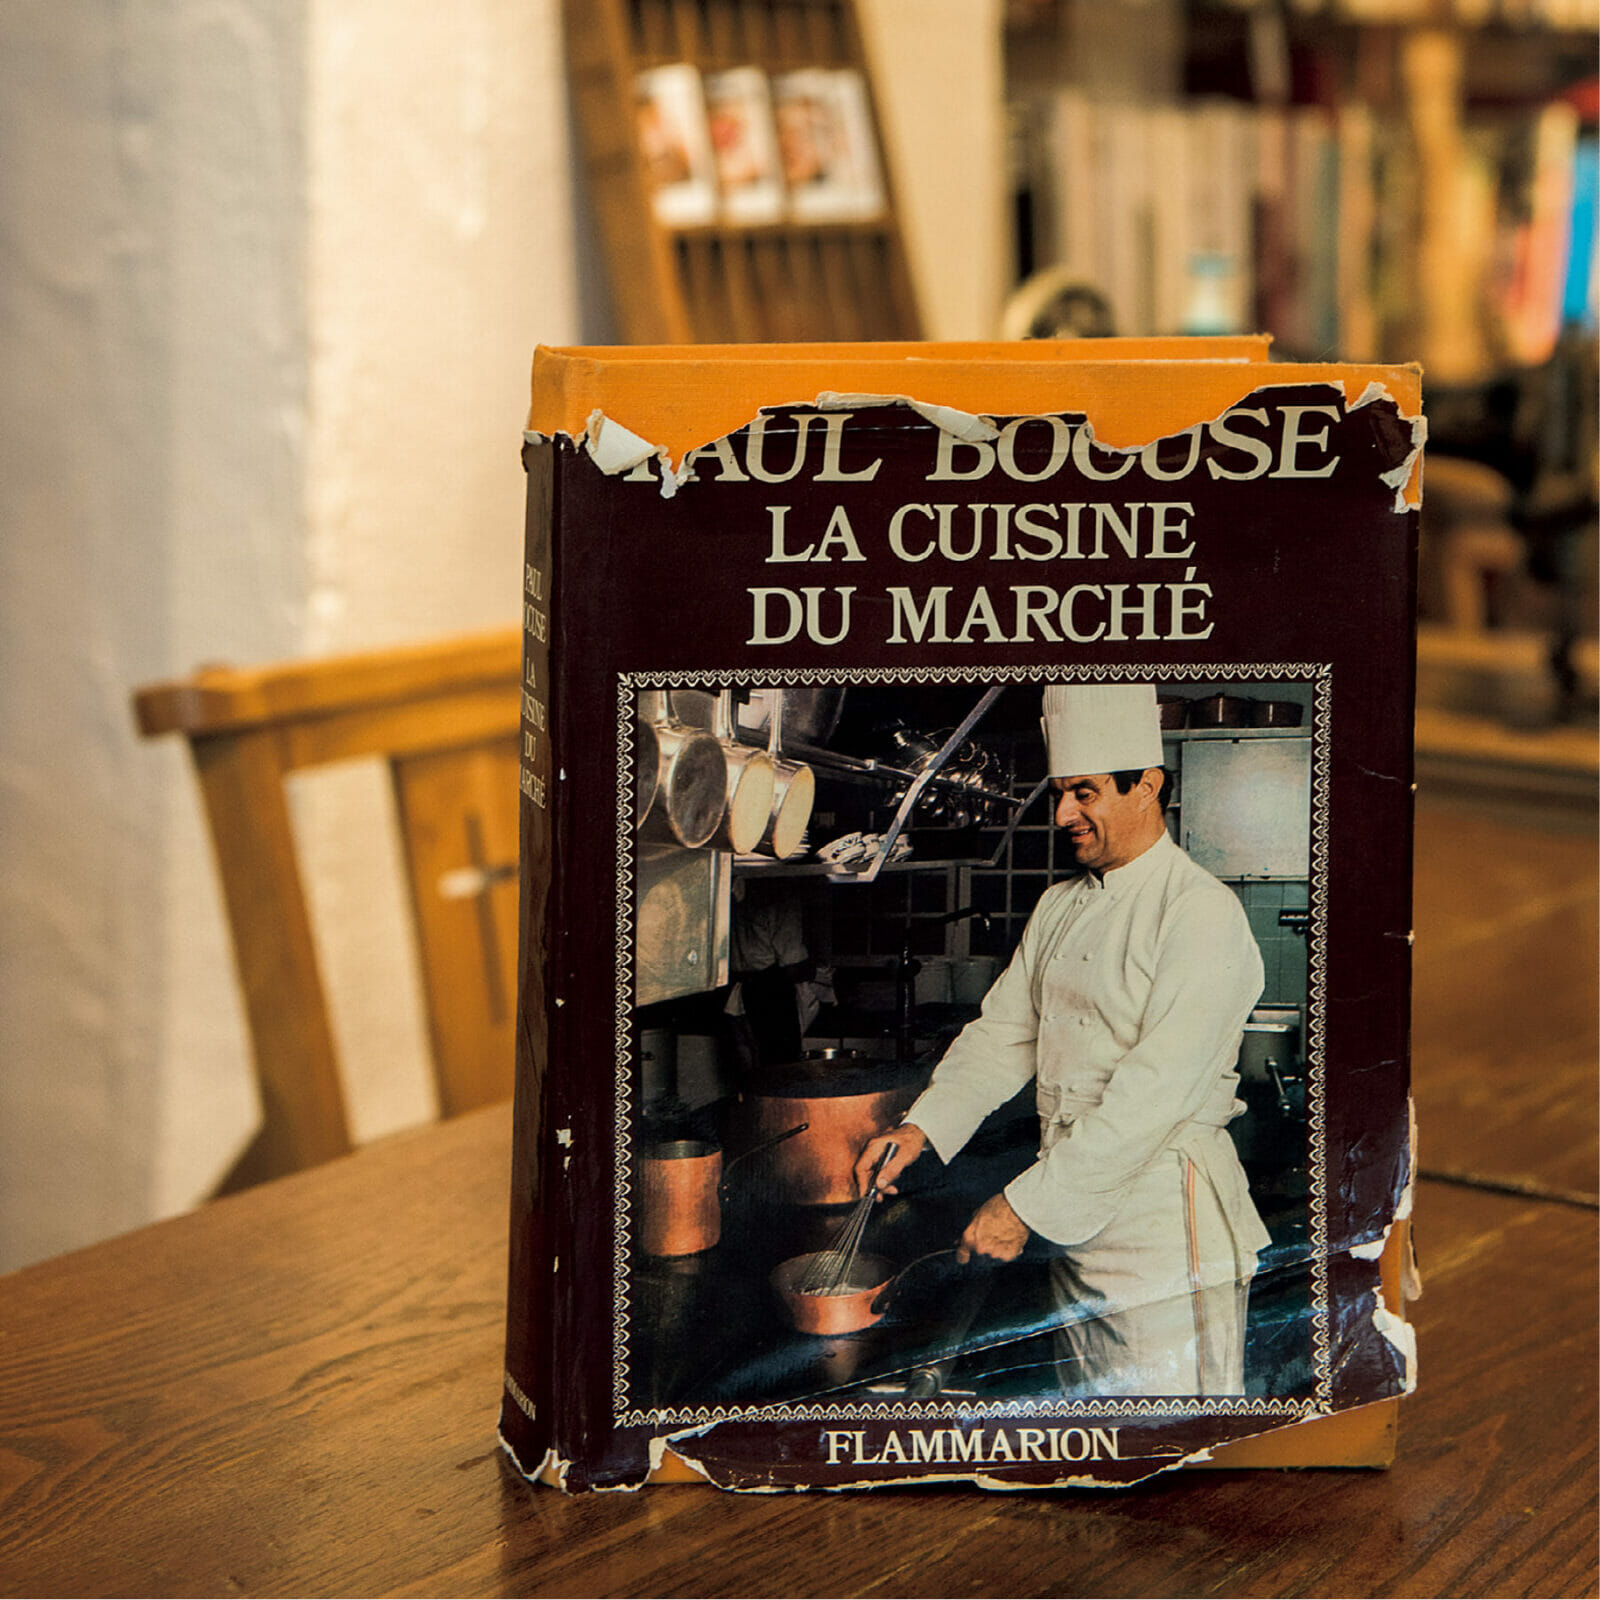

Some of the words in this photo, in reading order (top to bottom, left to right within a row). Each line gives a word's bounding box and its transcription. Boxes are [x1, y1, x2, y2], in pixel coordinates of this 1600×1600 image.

[765, 505, 867, 562] LA
[888, 502, 1196, 562] CUISINE
[746, 586, 857, 645] DU
[886, 566, 1215, 644] MARCHÉ
[825, 1427, 1120, 1465] FLAMMARION
